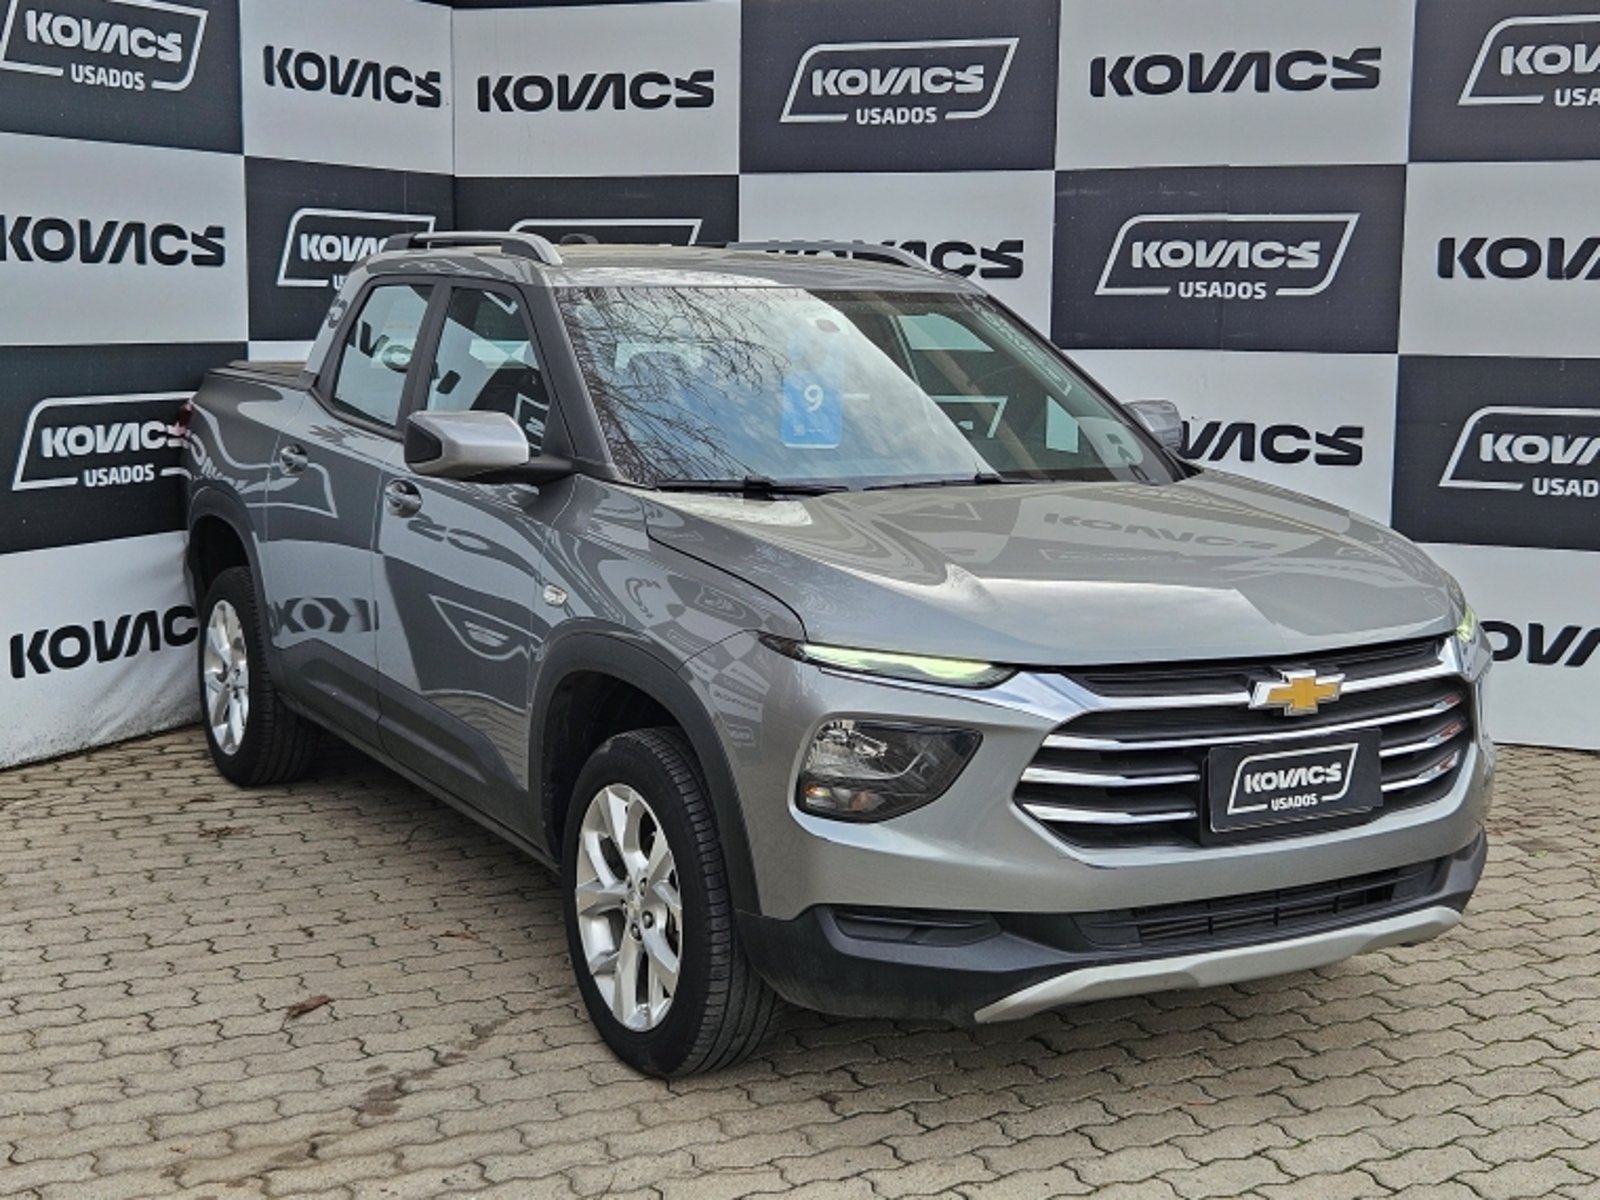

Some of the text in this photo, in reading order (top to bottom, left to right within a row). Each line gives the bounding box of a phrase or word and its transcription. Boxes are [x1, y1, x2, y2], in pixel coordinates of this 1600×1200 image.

[25, 10, 182, 62] KOVACS
[71, 63, 145, 90] USADOS
[264, 46, 441, 108] KOVACS
[813, 65, 984, 96] KOVACS
[1090, 47, 1381, 97] KOVACS
[478, 70, 714, 112] KOVACS
[857, 107, 937, 124] USADOS
[0, 215, 225, 267] KOVACS
[301, 234, 388, 261] KOVA
[1132, 240, 1320, 268] KOVACS
[1179, 282, 1266, 299] USADOS
[804, 384, 824, 412] 9
[84, 464, 154, 487] USADOS
[1244, 762, 1342, 794] KOVACS
[1271, 793, 1318, 811] USADOS
